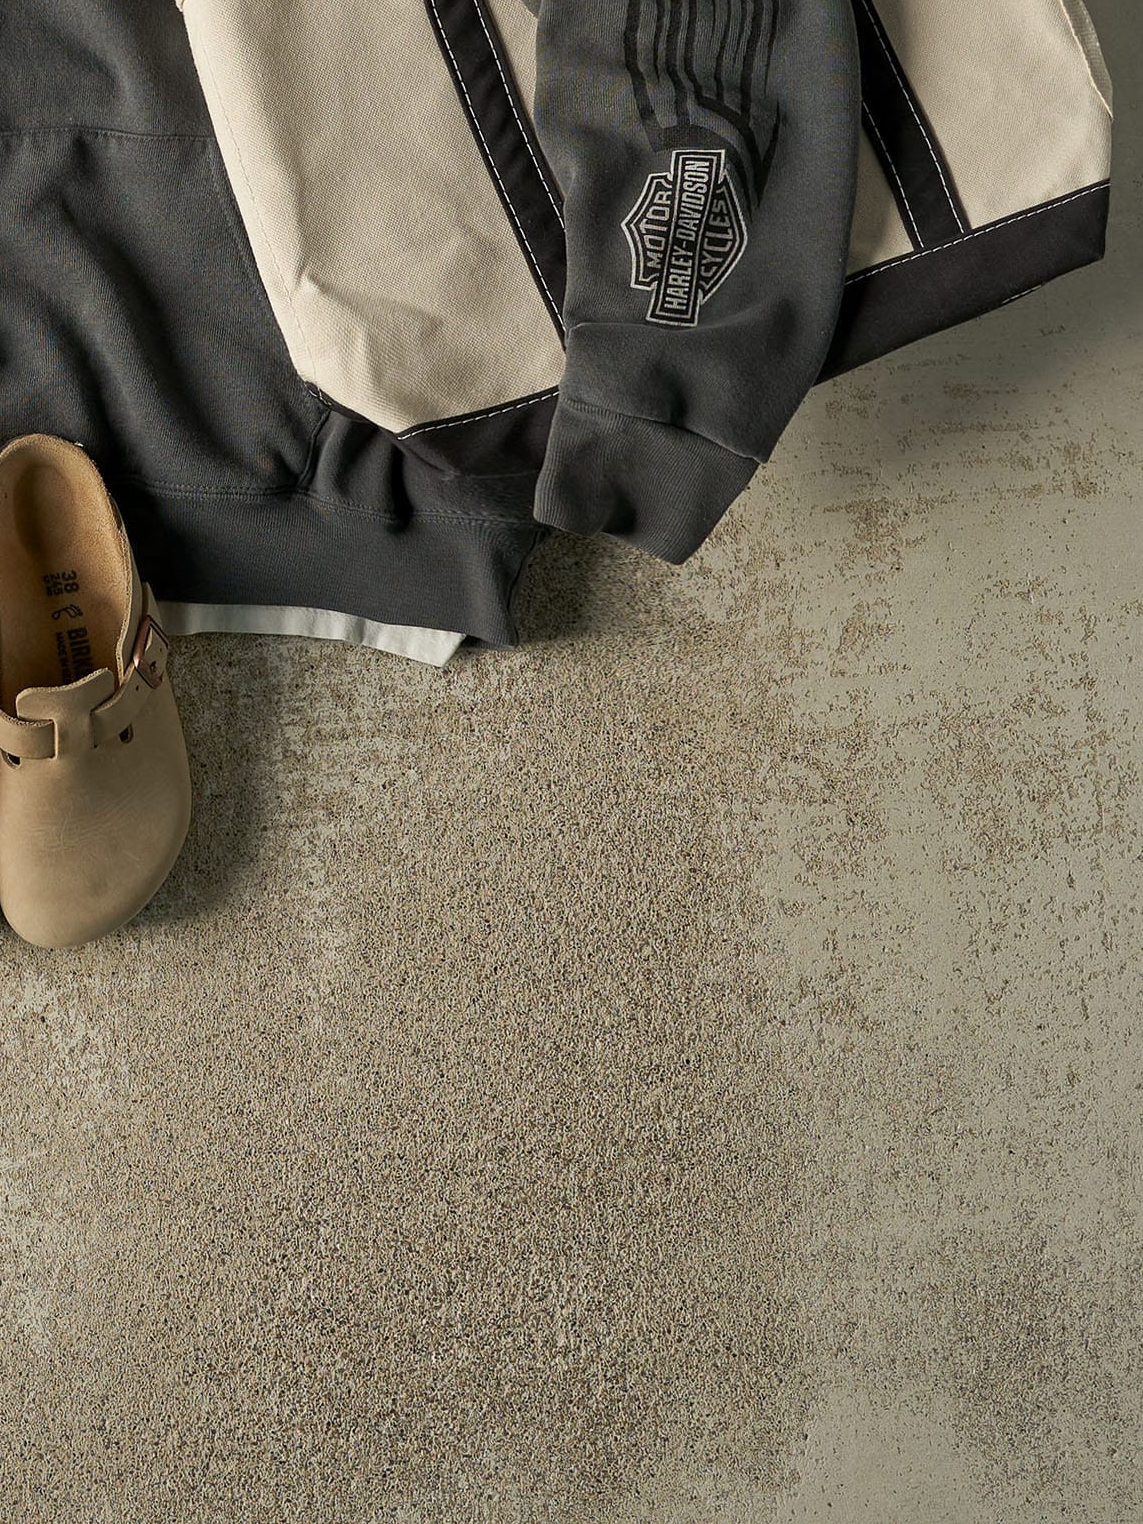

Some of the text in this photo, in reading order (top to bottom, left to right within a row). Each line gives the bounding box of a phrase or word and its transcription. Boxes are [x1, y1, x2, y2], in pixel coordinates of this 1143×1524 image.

[639, 190, 673, 269] MOTOR
[663, 160, 711, 310] HARLEY-DAVIDSON
[700, 198, 734, 280] CYCLES
[61, 569, 80, 594] 38
[66, 627, 94, 677] BIRK
